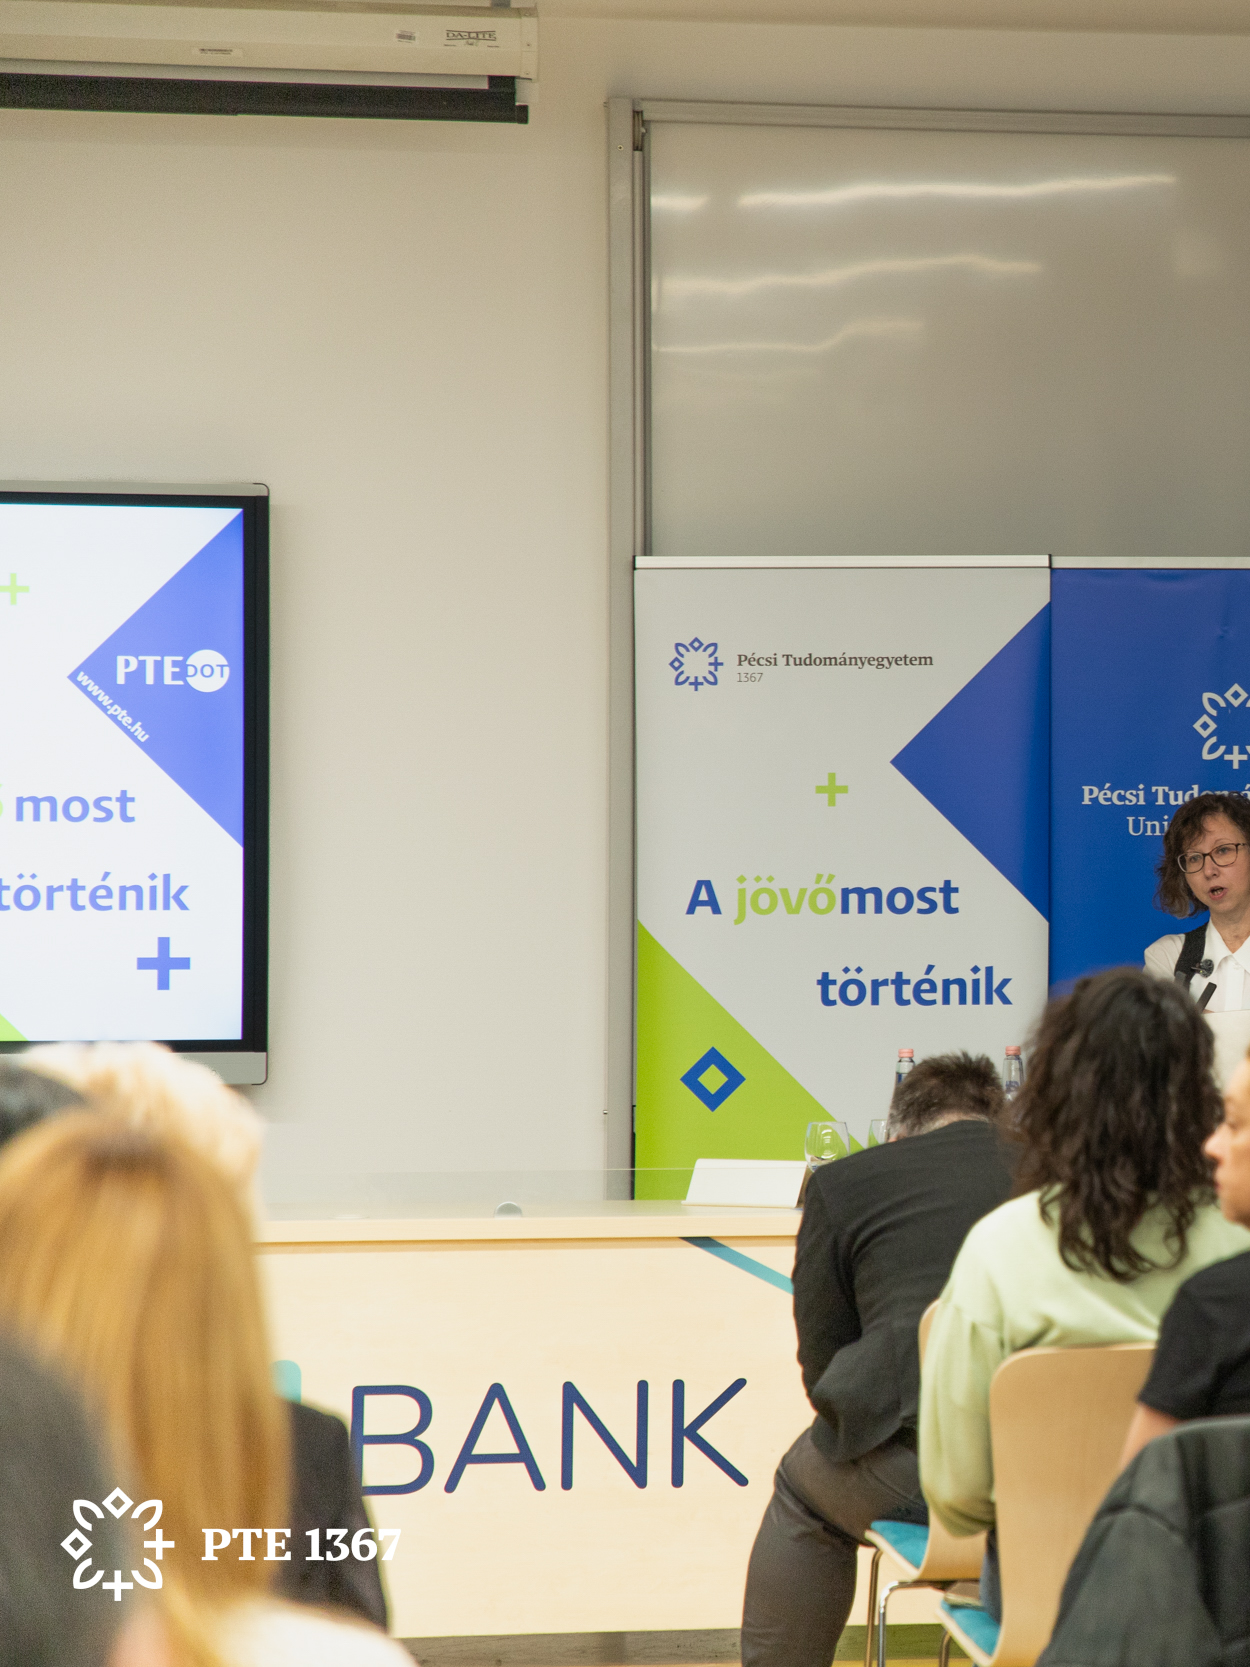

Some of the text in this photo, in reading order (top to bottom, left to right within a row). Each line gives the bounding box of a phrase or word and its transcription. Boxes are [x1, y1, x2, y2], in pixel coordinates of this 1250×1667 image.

[116, 655, 185, 685] PTE
[736, 652, 935, 670] Pécsi Tudományegyetem
[736, 672, 764, 683] 1367
[76, 671, 150, 743] www.pte.hu
[1082, 783, 1147, 806] Pécsi
[684, 879, 722, 916] A
[816, 964, 1014, 1007] történik
[350, 1378, 749, 1496] BANK
